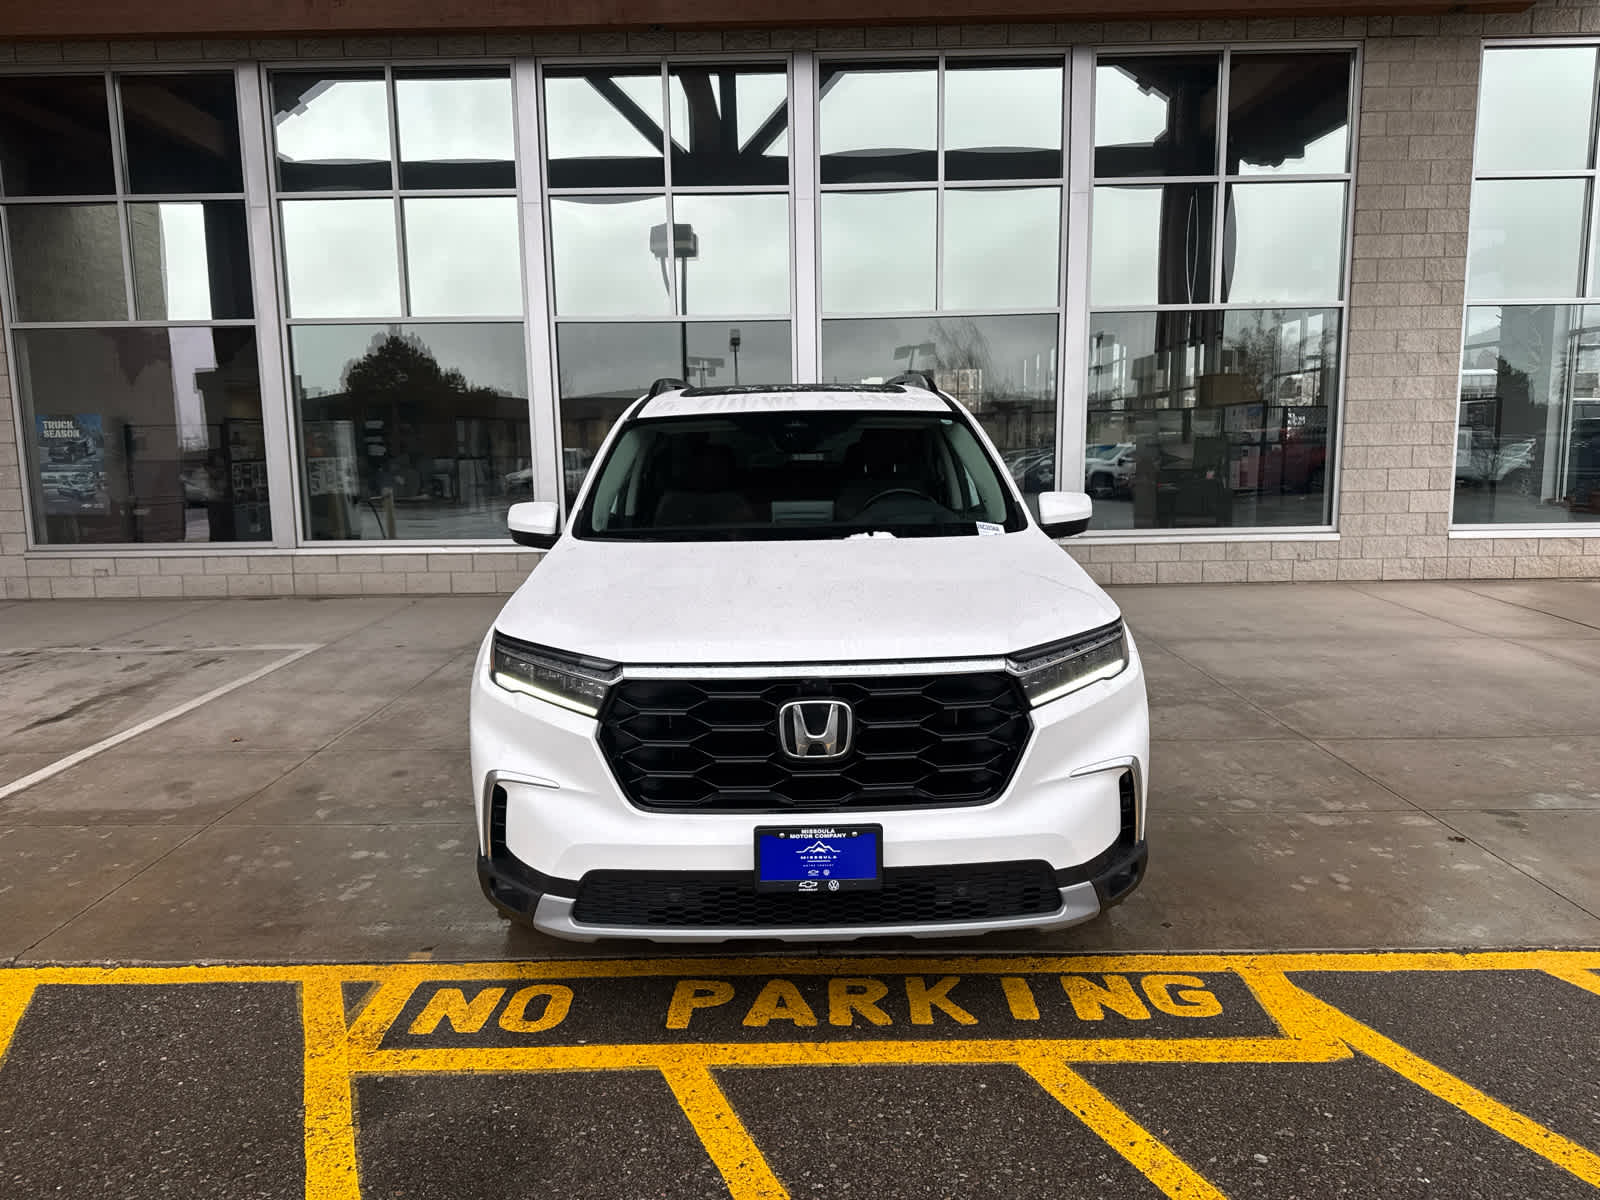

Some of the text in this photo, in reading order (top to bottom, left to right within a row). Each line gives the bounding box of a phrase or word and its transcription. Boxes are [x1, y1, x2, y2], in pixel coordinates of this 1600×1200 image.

[42, 421, 74, 429] TRUCK
[43, 430, 80, 438] SEASON
[407, 975, 1224, 1035] NO PARKING
